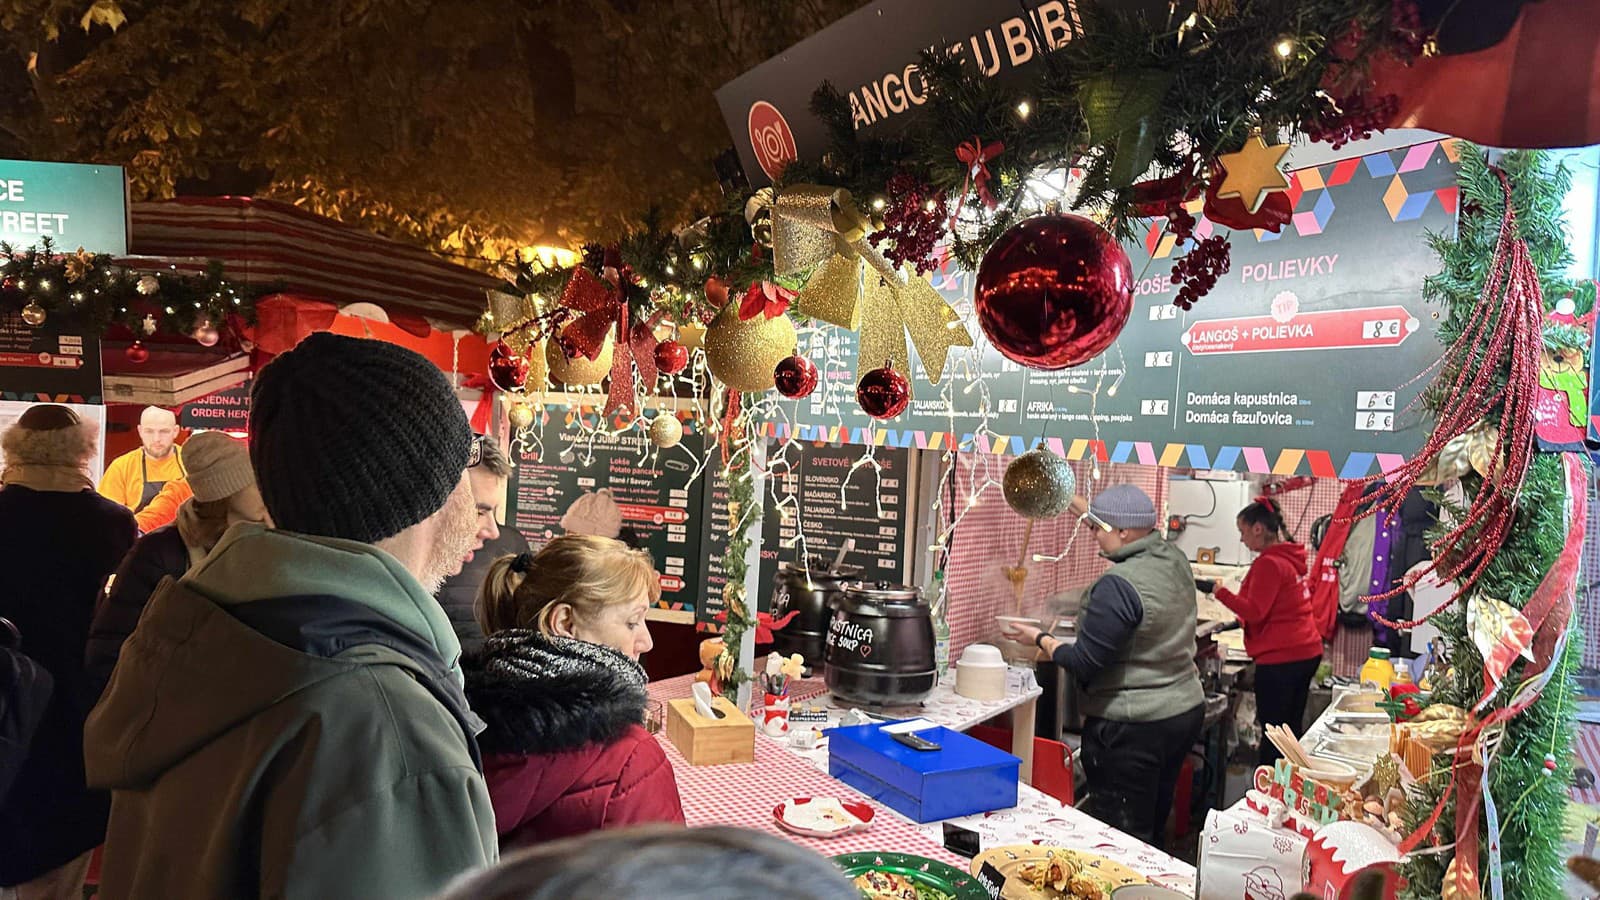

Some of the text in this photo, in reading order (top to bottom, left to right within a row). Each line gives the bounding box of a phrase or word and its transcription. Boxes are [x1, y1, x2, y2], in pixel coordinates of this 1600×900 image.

[0, 211, 69, 235] REET
[1242, 253, 1339, 283] POLIEVKY
[1192, 326, 1239, 343] LANGOŠ
[1252, 323, 1314, 340] POLIEVKA
[1373, 321, 1383, 338] 8
[1027, 401, 1054, 412] AFRIKA
[1187, 392, 1298, 408] Domáca kapustnica
[191, 408, 251, 418] ORDER HER
[1185, 410, 1229, 423] Domáca
[1232, 411, 1292, 425] fazuľovica
[521, 452, 538, 460] Grill
[812, 456, 849, 467] SVETOVÉ
[610, 466, 631, 474] Potato
